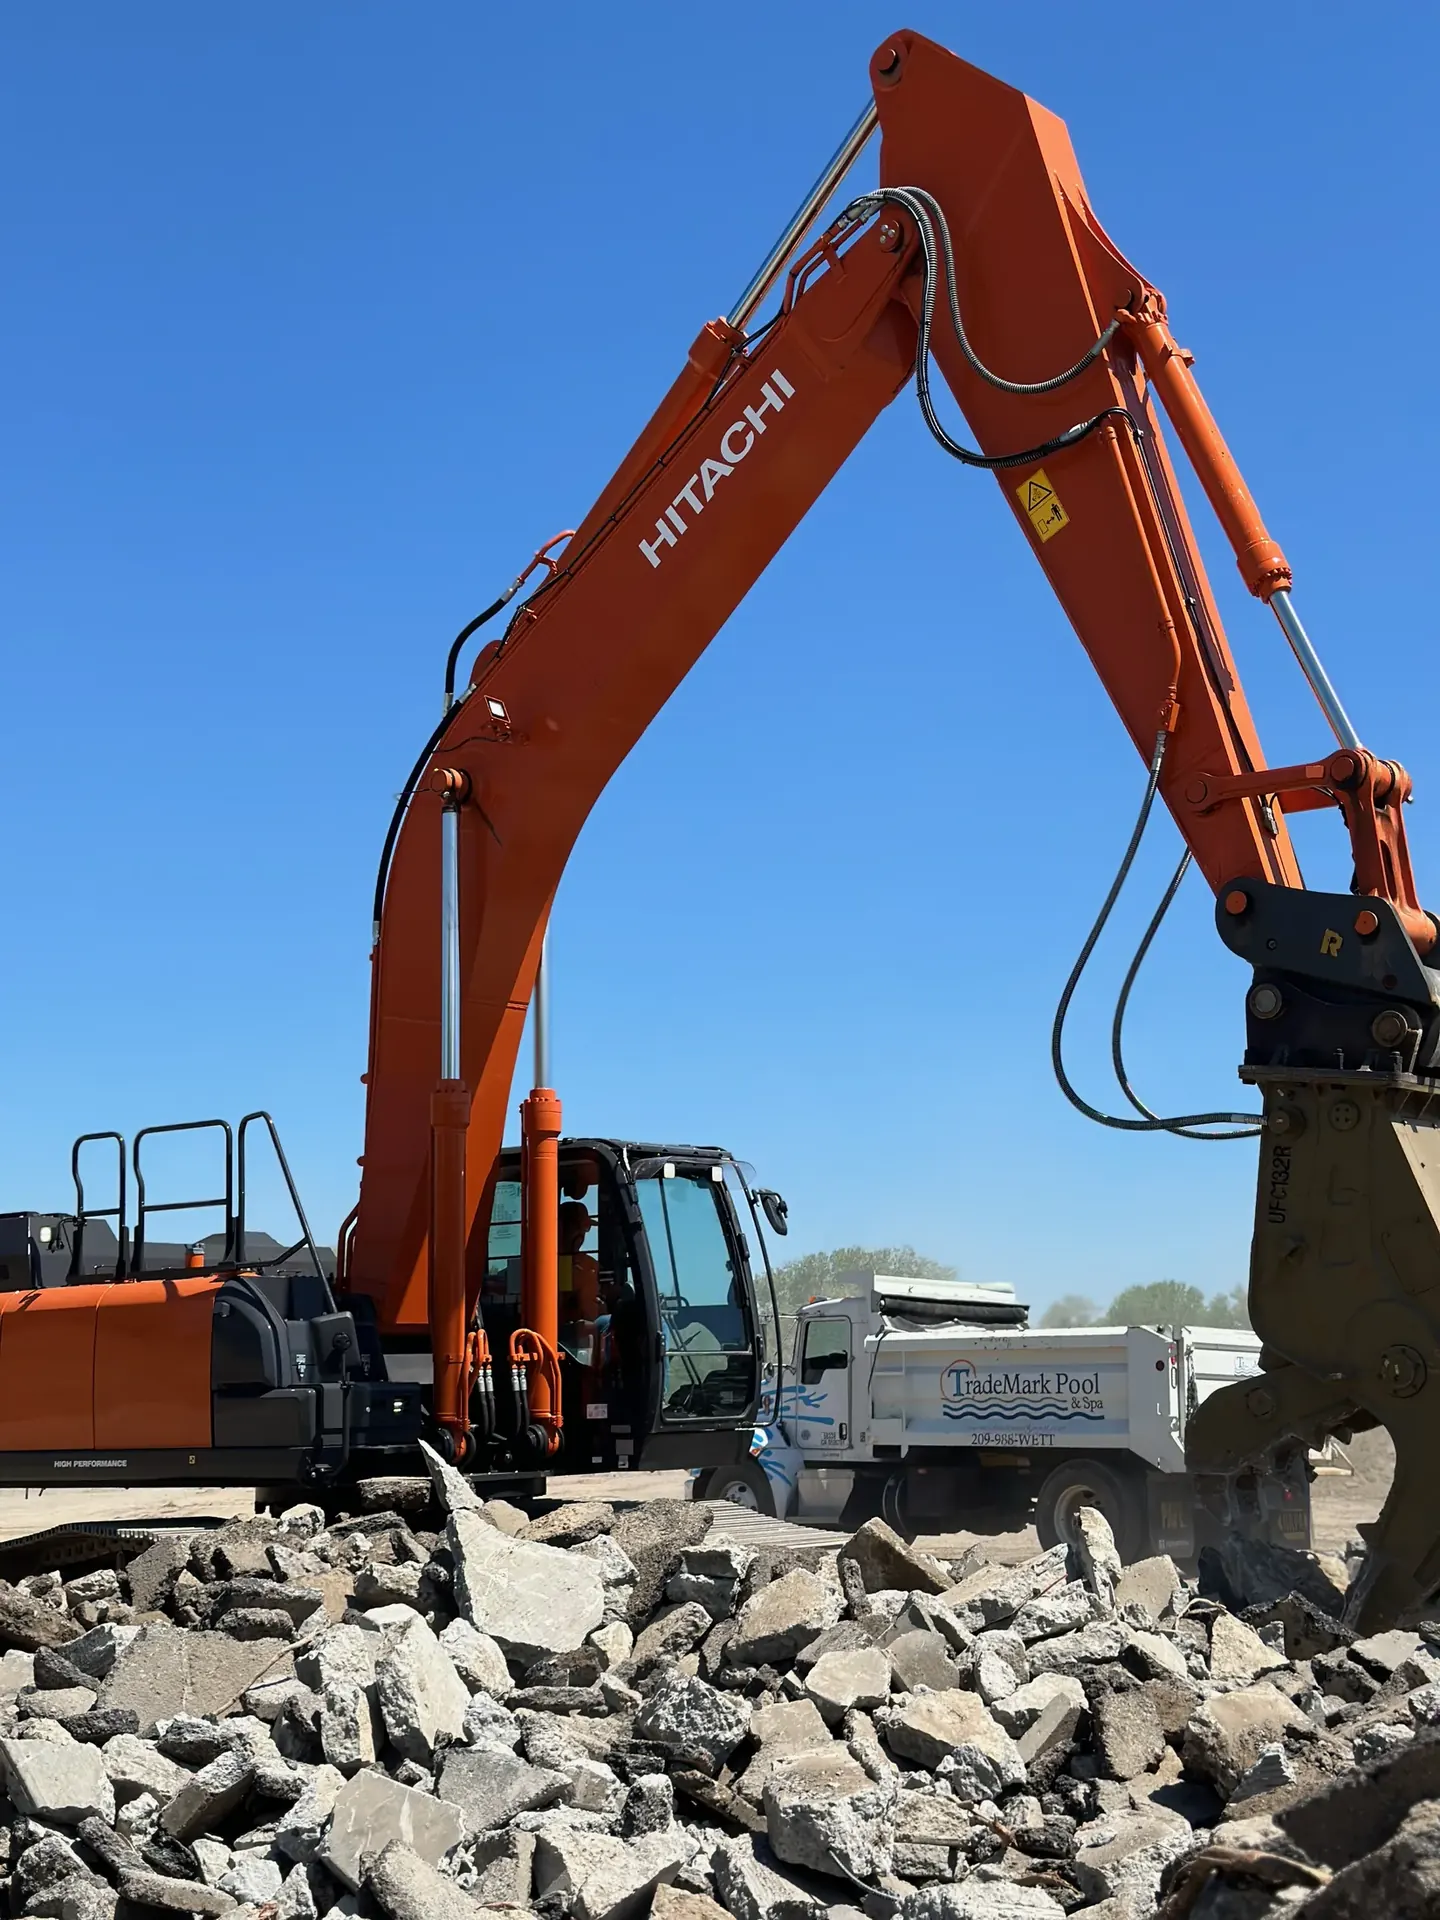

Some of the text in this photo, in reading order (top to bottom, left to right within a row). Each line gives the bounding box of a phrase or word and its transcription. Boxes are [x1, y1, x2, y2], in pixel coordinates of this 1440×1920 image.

[638, 368, 796, 569] HITACHI
[1268, 1145, 1293, 1224] UFC132R
[947, 1368, 1100, 1397] TradeMark Pool
[1071, 1396, 1104, 1413] & Spa
[971, 1432, 1056, 1446] 209-988-WETT
[53, 1459, 128, 1468] HIGH PERFORMANCE
